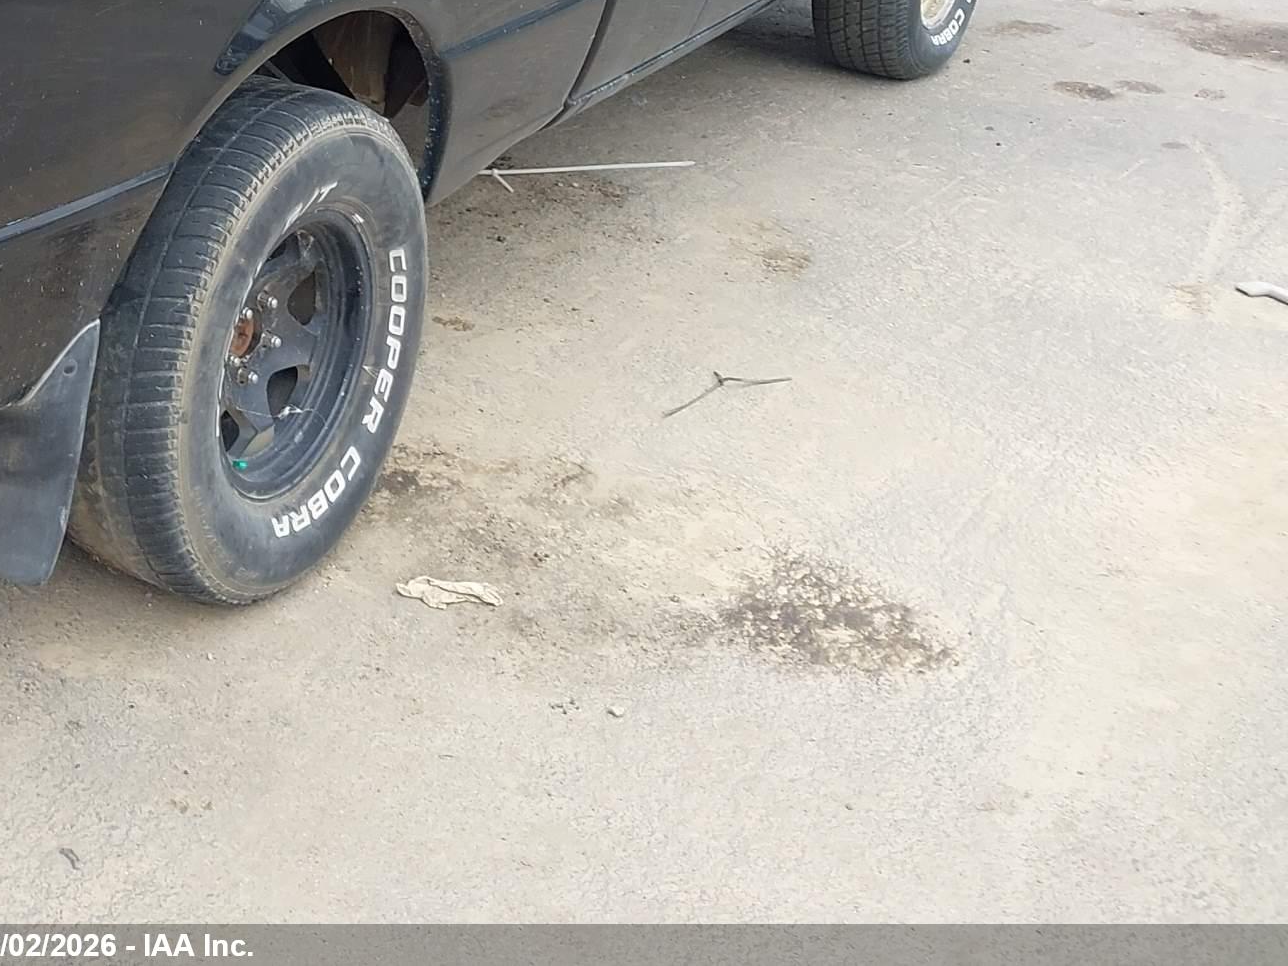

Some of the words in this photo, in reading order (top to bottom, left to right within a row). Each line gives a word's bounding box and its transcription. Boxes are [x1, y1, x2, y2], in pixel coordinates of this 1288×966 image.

[930, 8, 966, 46] COBRA
[361, 248, 408, 434] COOPER
[271, 445, 362, 539] COBRA
